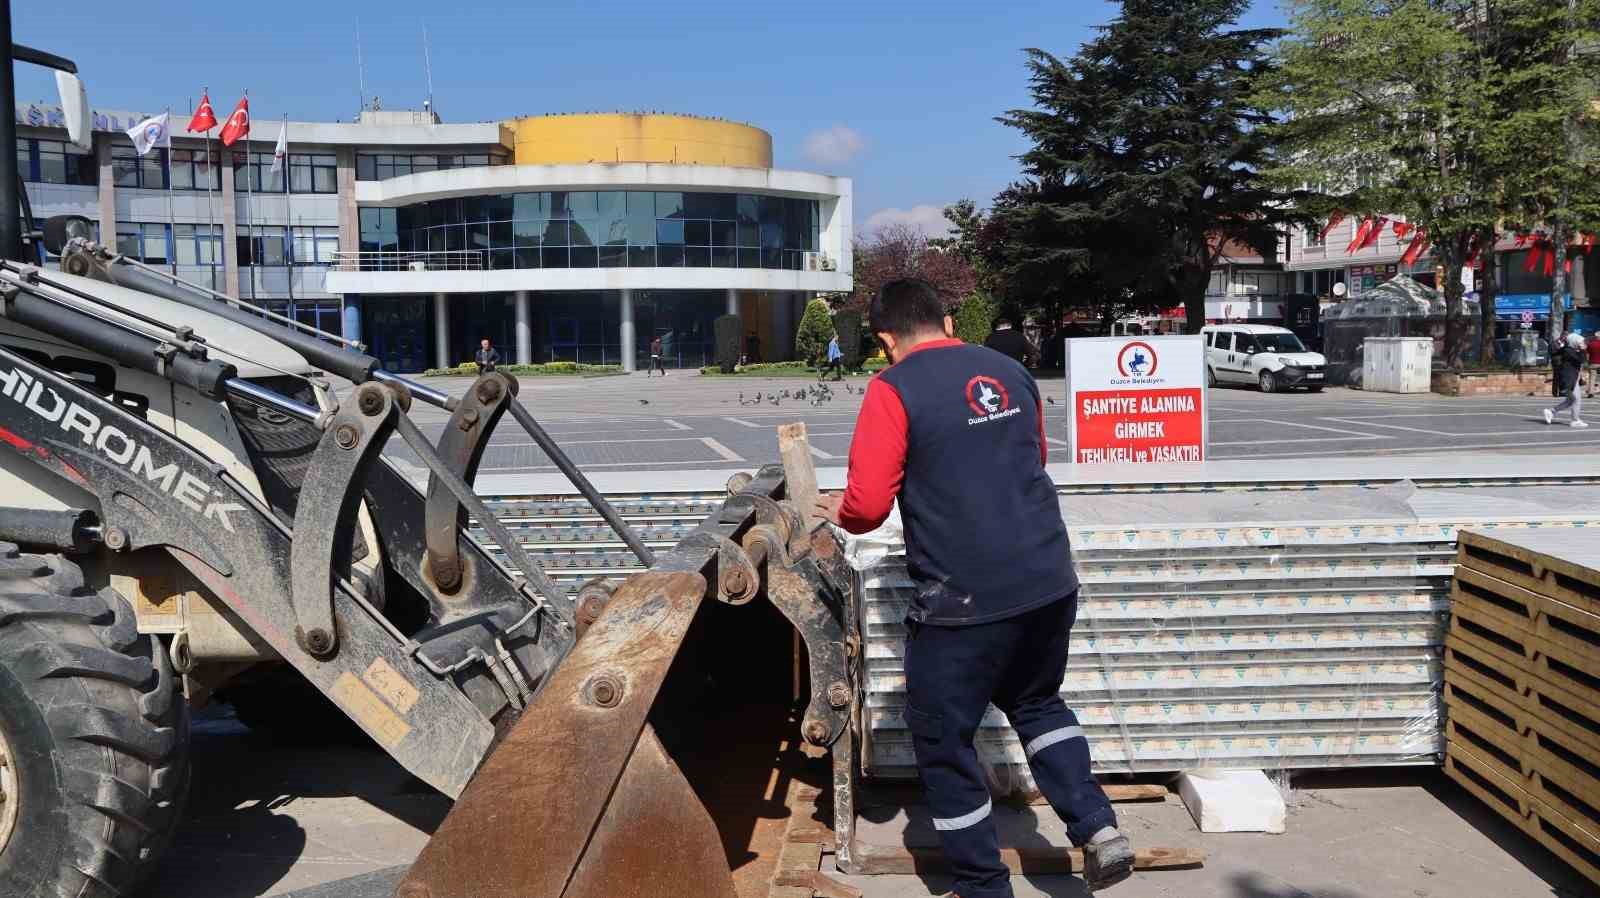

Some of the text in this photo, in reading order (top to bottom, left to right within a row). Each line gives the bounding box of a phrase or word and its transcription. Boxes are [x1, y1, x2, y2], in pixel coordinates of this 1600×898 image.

[1083, 393, 1195, 420] ŞANTİYE ALANINA
[1115, 419, 1165, 439] GİRMEK
[1079, 443, 1200, 464] TEHLİKELİ ve YASAKTIR
